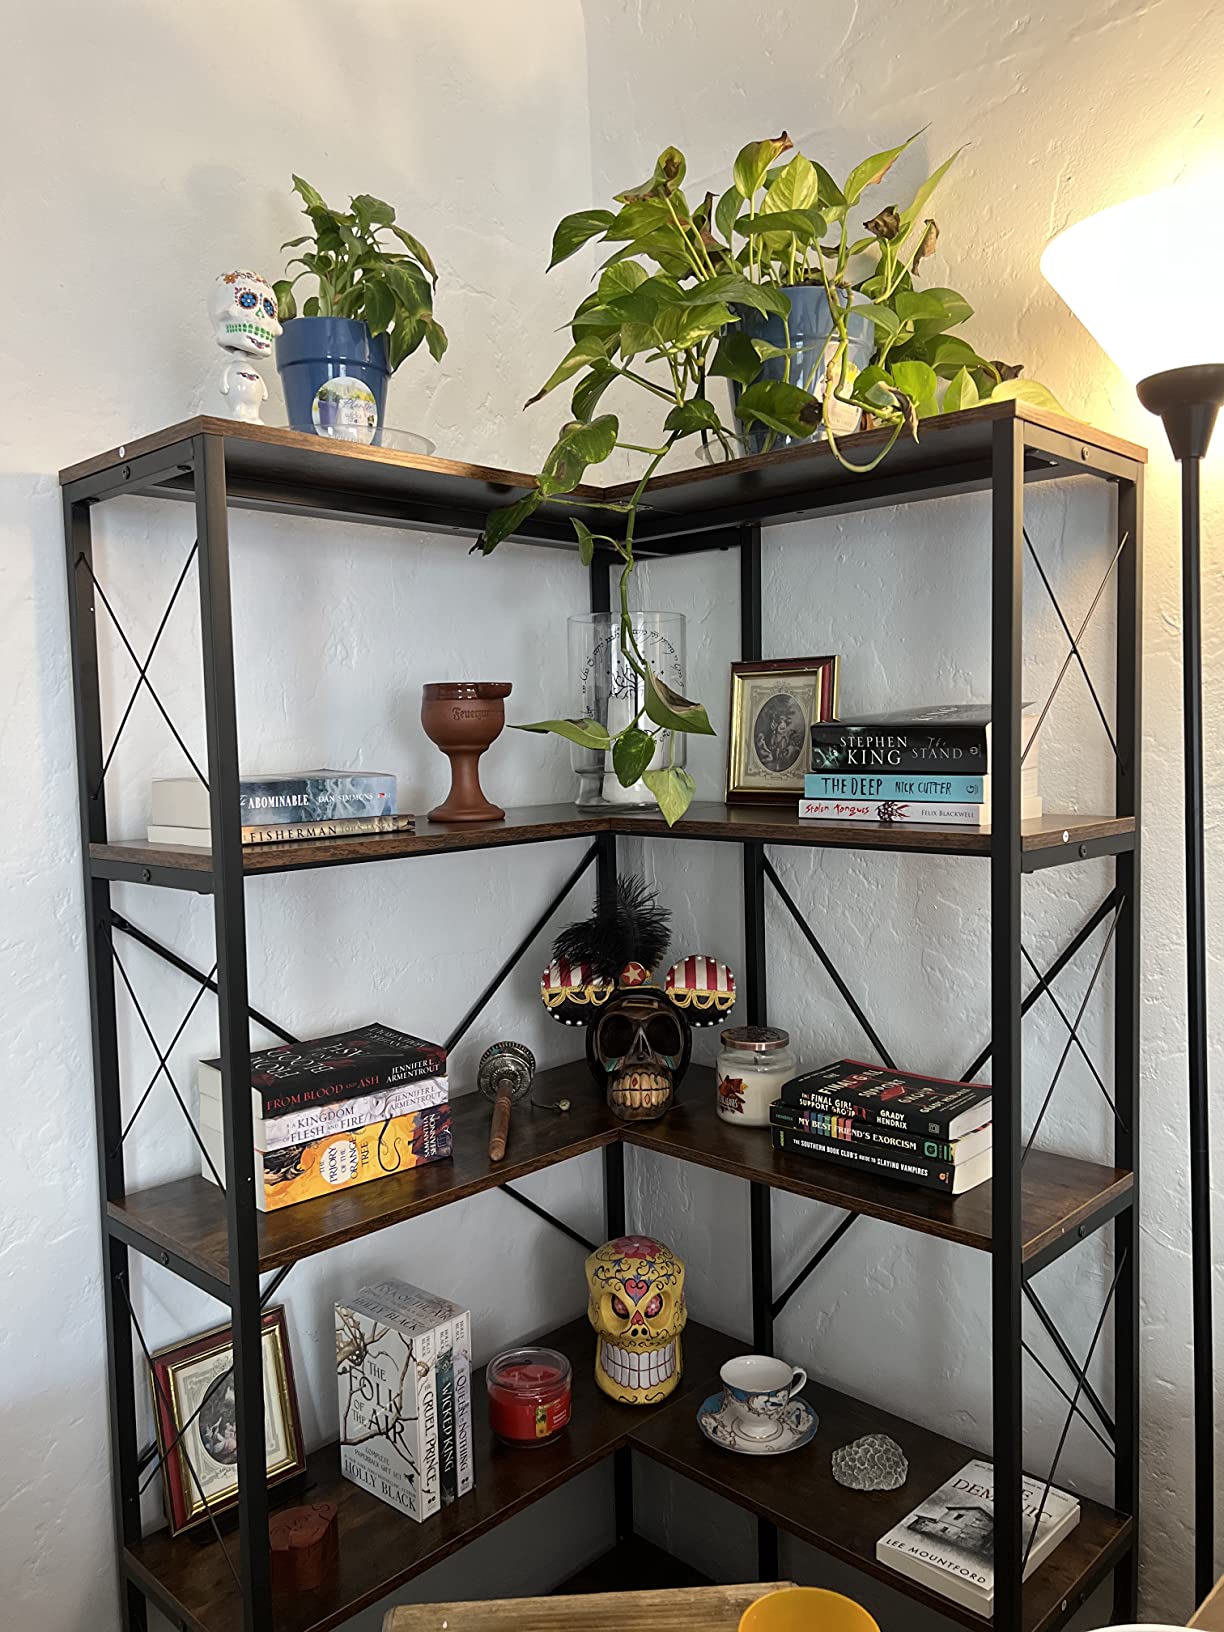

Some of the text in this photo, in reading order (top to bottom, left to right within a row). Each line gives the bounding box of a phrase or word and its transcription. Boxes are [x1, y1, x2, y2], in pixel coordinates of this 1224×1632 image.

[840, 736, 908, 748] STEPHEN
[928, 736, 947, 749] The
[847, 749, 901, 765] KING
[911, 747, 963, 760] STAND
[821, 778, 883, 796] THE DEEP
[895, 781, 952, 796] NICK CUTTER
[248, 794, 309, 809] ABOMINABLE
[318, 792, 373, 803] DAN SIMMONS
[939, 810, 975, 818] BLACKWELL
[250, 825, 337, 842] FISHERMAN
[267, 1050, 335, 1074] BLOOD
[392, 1060, 428, 1074] JENNIFER
[386, 1065, 440, 1083] ARMENTROUT
[266, 1095, 301, 1111] FROM
[303, 1085, 343, 1102] BLOOD
[357, 1075, 380, 1090] ASH
[390, 1092, 442, 1111] ARMENTROUT
[395, 1088, 429, 1102] JENNIFER
[811, 1093, 832, 1106] FINAL
[835, 1099, 853, 1110] GIRL
[298, 1106, 355, 1128] KINGDOM
[799, 1098, 856, 1117] SUPPORT GROUP
[880, 1109, 905, 1120] GRADY
[290, 1127, 324, 1143] FLESH
[340, 1115, 365, 1130] FIRE
[876, 1116, 907, 1130] HENDRIX
[798, 1117, 917, 1150] MY BEST FRIEND'S EXORCISM
[350, 1137, 358, 1180] ORANGE
[361, 1141, 369, 1167] TREE
[801, 1140, 825, 1152] SOUTHERN
[826, 1146, 840, 1155] BOOK
[840, 1149, 858, 1160] CLUB'S
[876, 1158, 900, 1170] SLAYING
[900, 1163, 929, 1176] VAMPIRES
[329, 1147, 338, 1183] PRIORY
[352, 1297, 419, 1331] HOLLY BLACK
[367, 1361, 387, 1381] THE
[349, 1365, 402, 1417] FOLK
[456, 1375, 468, 1417] QUEEN
[353, 1399, 365, 1412] OF
[422, 1391, 435, 1436] CRUEL
[352, 1408, 367, 1426] THE
[368, 1408, 409, 1450] AIR
[442, 1383, 455, 1473] WICKED KING
[459, 1422, 469, 1472] NOTHING
[425, 1436, 438, 1486] PRINCE
[344, 1460, 377, 1488] HOLLY
[381, 1482, 416, 1512] BLACK
[885, 1538, 986, 1584] LEE MOUNTFORD
